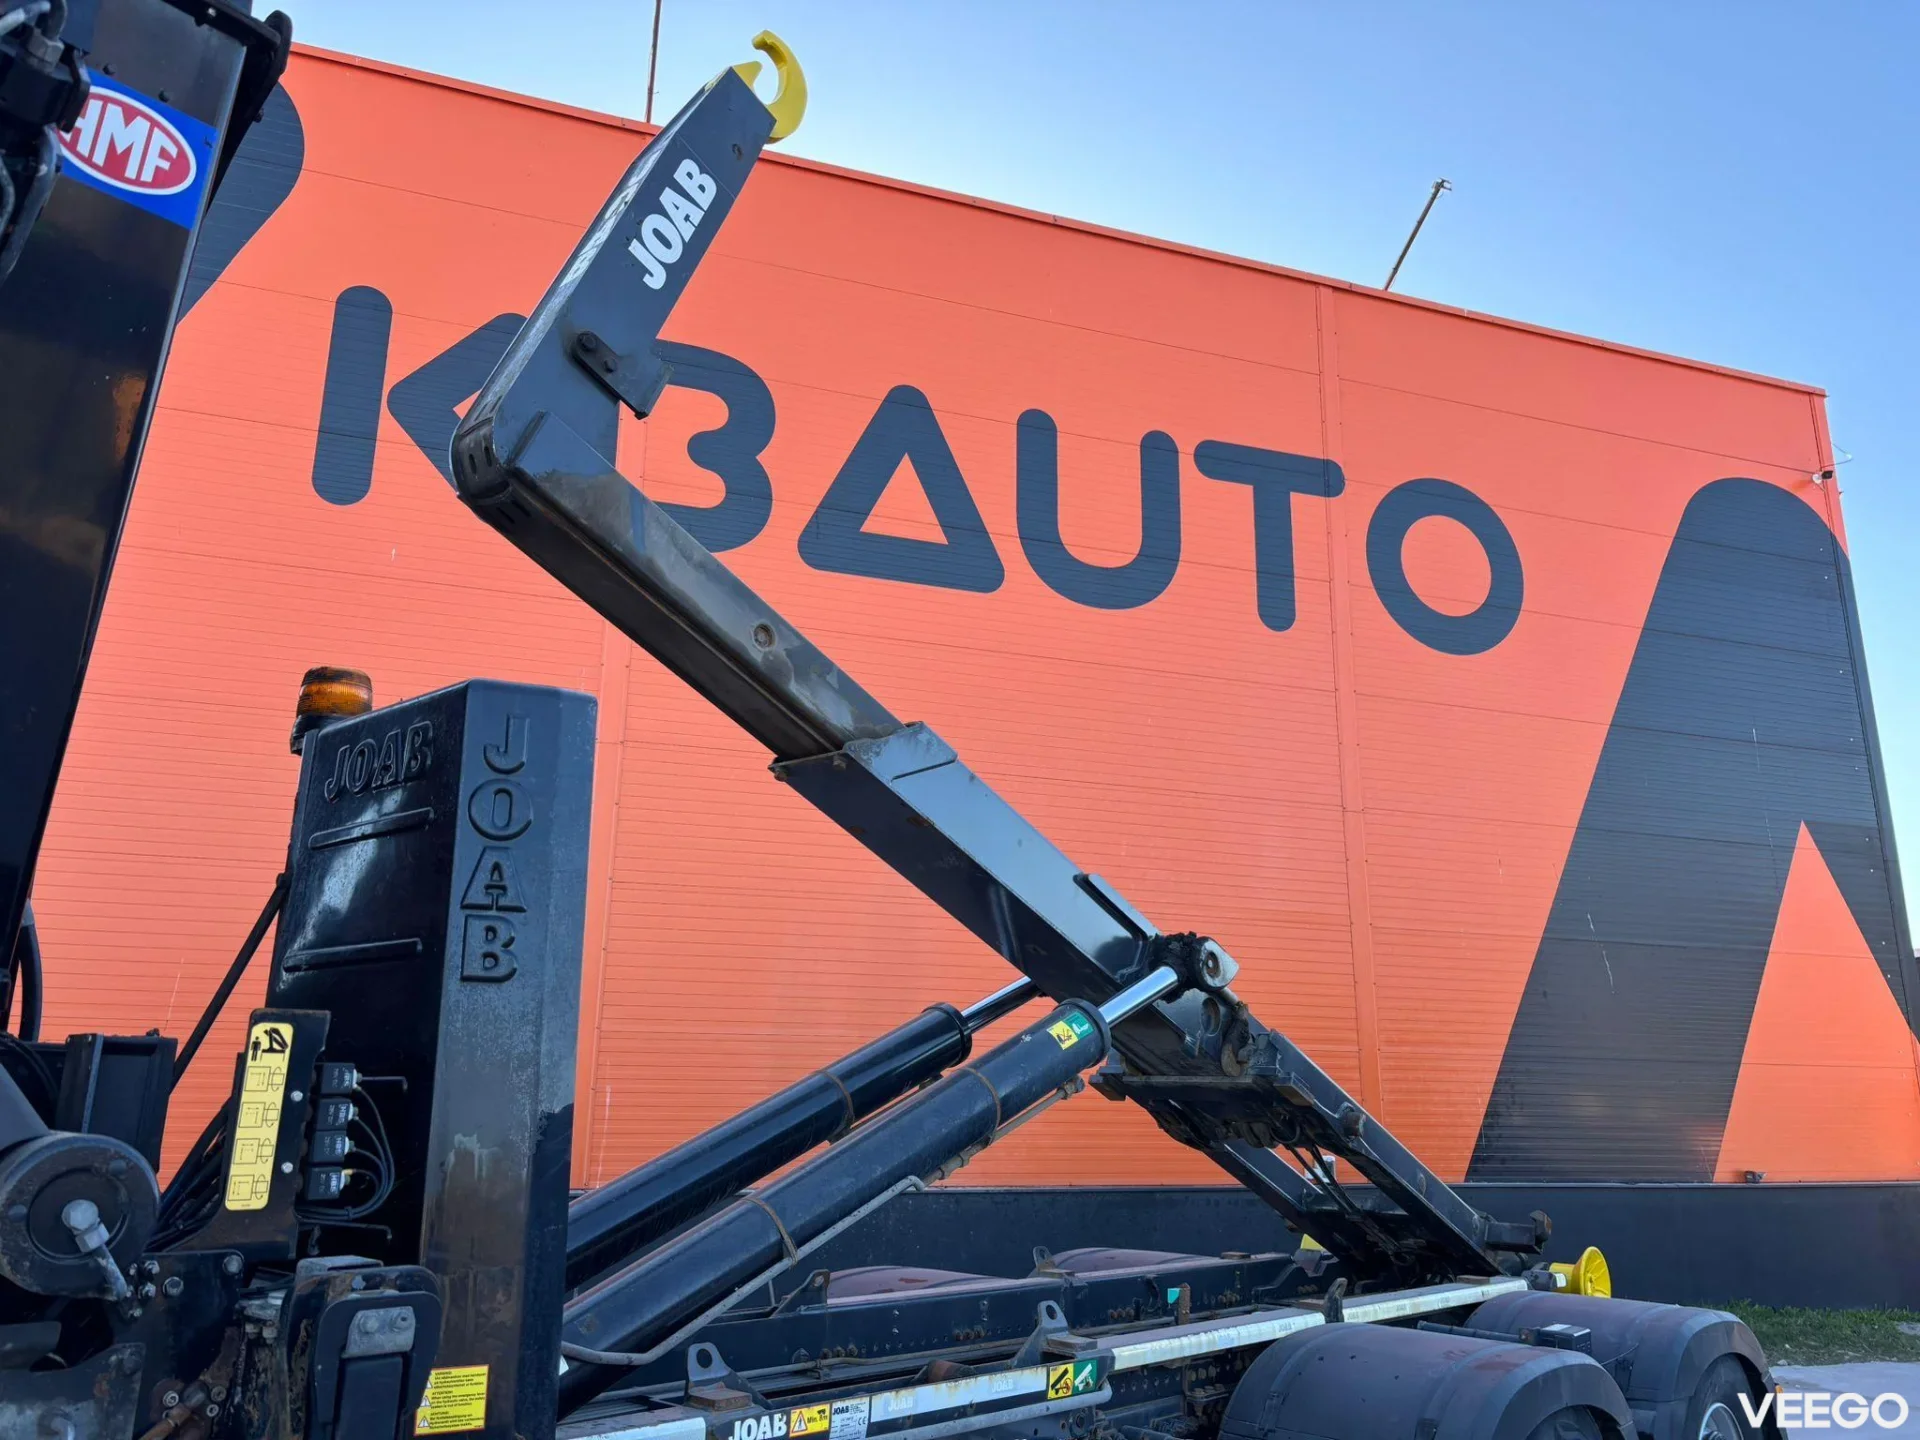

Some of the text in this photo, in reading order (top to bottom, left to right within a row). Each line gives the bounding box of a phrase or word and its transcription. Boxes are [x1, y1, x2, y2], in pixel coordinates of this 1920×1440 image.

[60, 99, 178, 183] HMF
[627, 158, 717, 290] JOAB
[324, 720, 434, 804] JOAB
[459, 713, 533, 984] JOAB
[728, 1413, 787, 1440] JOAB
[833, 1406, 849, 1415] JOAB
